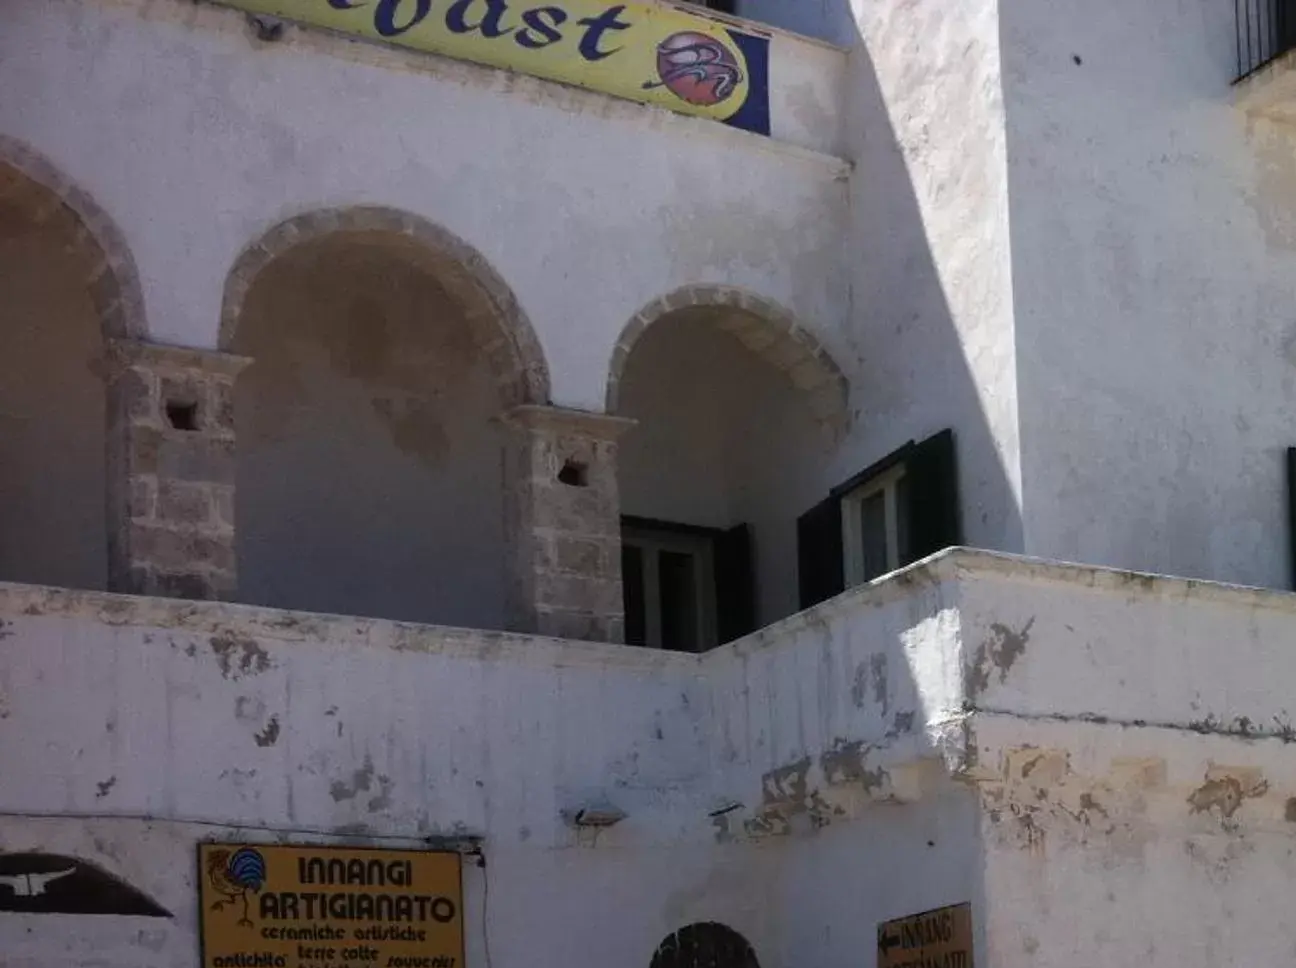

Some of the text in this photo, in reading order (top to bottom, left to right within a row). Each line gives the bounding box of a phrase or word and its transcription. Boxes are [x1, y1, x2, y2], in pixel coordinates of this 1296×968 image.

[298, 857, 412, 886] INNANGI
[259, 892, 456, 923] ARTIGIANATO
[261, 924, 427, 942] ceramiche artistiche
[297, 945, 380, 961] terre cotte
